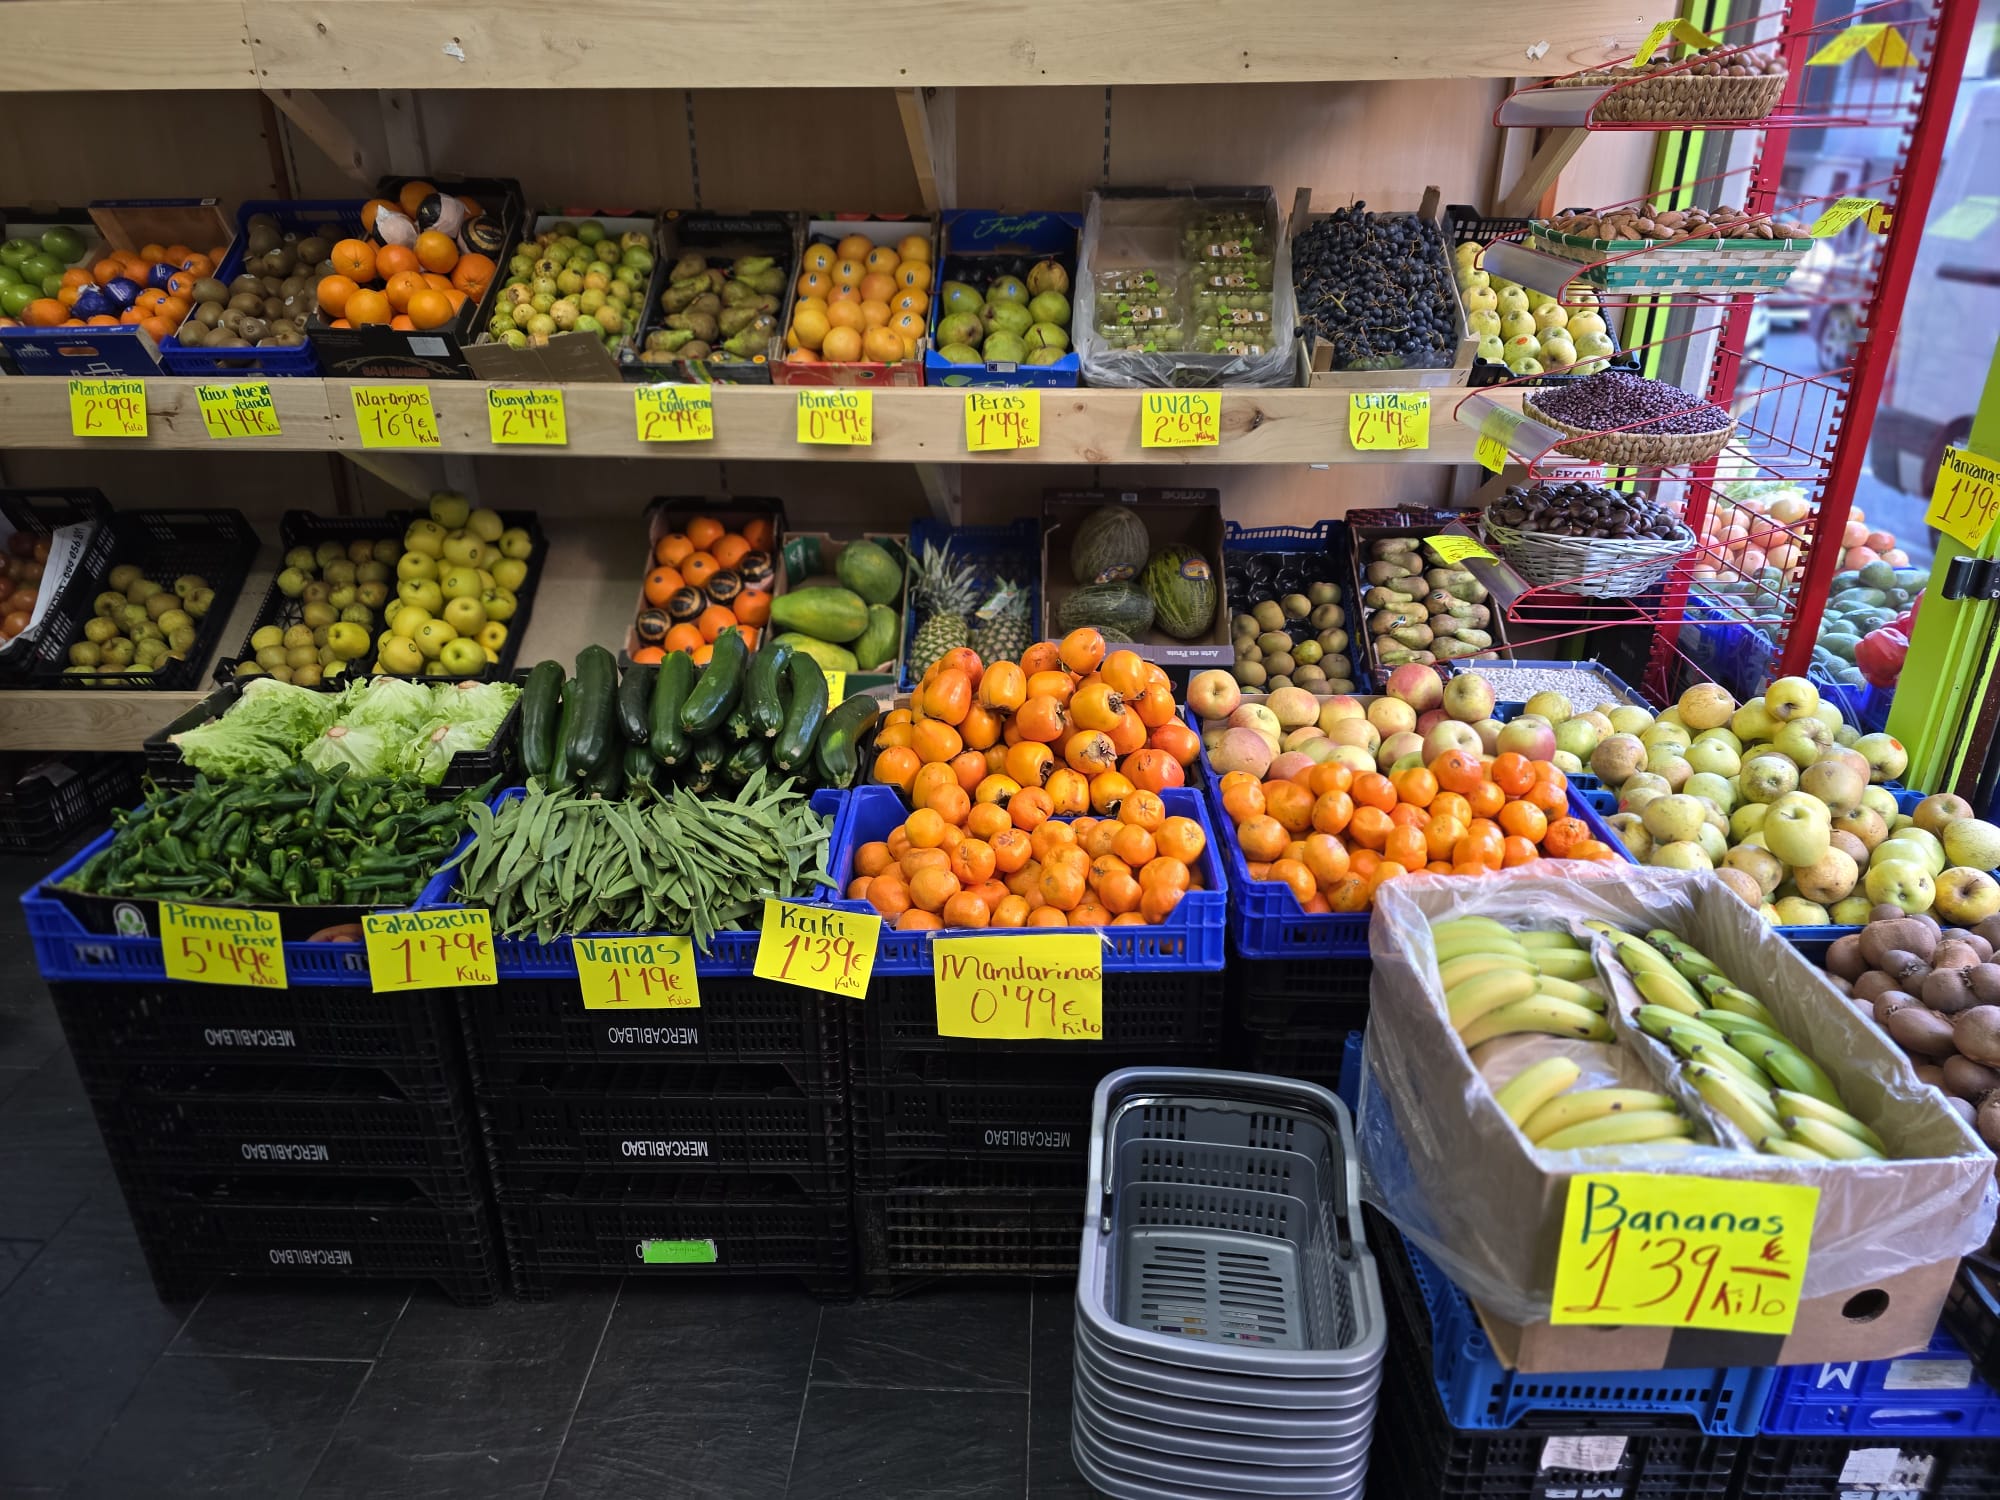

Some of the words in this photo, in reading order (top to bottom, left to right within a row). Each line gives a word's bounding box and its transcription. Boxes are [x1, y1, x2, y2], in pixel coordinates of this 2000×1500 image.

[69, 380, 143, 395] Mandarina
[355, 390, 430, 413] Naranjas
[489, 389, 559, 410] Guayabas
[636, 387, 679, 402] Pera
[798, 388, 858, 408] Pomelo
[84, 397, 141, 430] 2'99€
[968, 393, 1026, 412] Peras
[206, 408, 268, 436] 4'99€
[370, 408, 428, 439] 1'69€
[502, 408, 558, 437] 2'99€
[644, 409, 703, 440] 2'99€
[810, 408, 868, 440] 0'99€
[975, 411, 1031, 446] 1'99€
[1154, 411, 1213, 443] 2'69€
[1356, 409, 1412, 444] 2'49€
[163, 903, 273, 932] Pimiento
[366, 909, 485, 934] Calabacin
[181, 936, 274, 976] 5'49€
[391, 932, 489, 984] 1'79€
[575, 940, 681, 965] Vainas
[769, 934, 868, 980] 1'39€
[942, 953, 1101, 981] Mandarinas
[605, 966, 684, 1004] 1'19€
[204, 1028, 297, 1047] MERCABILBAO
[608, 1026, 699, 1045] MERCABILBAO
[1063, 1018, 1101, 1035] Kilo
[241, 1143, 330, 1161] MERCABILBAO
[620, 1141, 709, 1157] MERCABILBAO
[984, 1129, 1071, 1148] MERCABILBAO
[1581, 1181, 1784, 1245] Bananas
[269, 1249, 353, 1265] MERCABILBAO
[1711, 1281, 1786, 1316] Kilo
